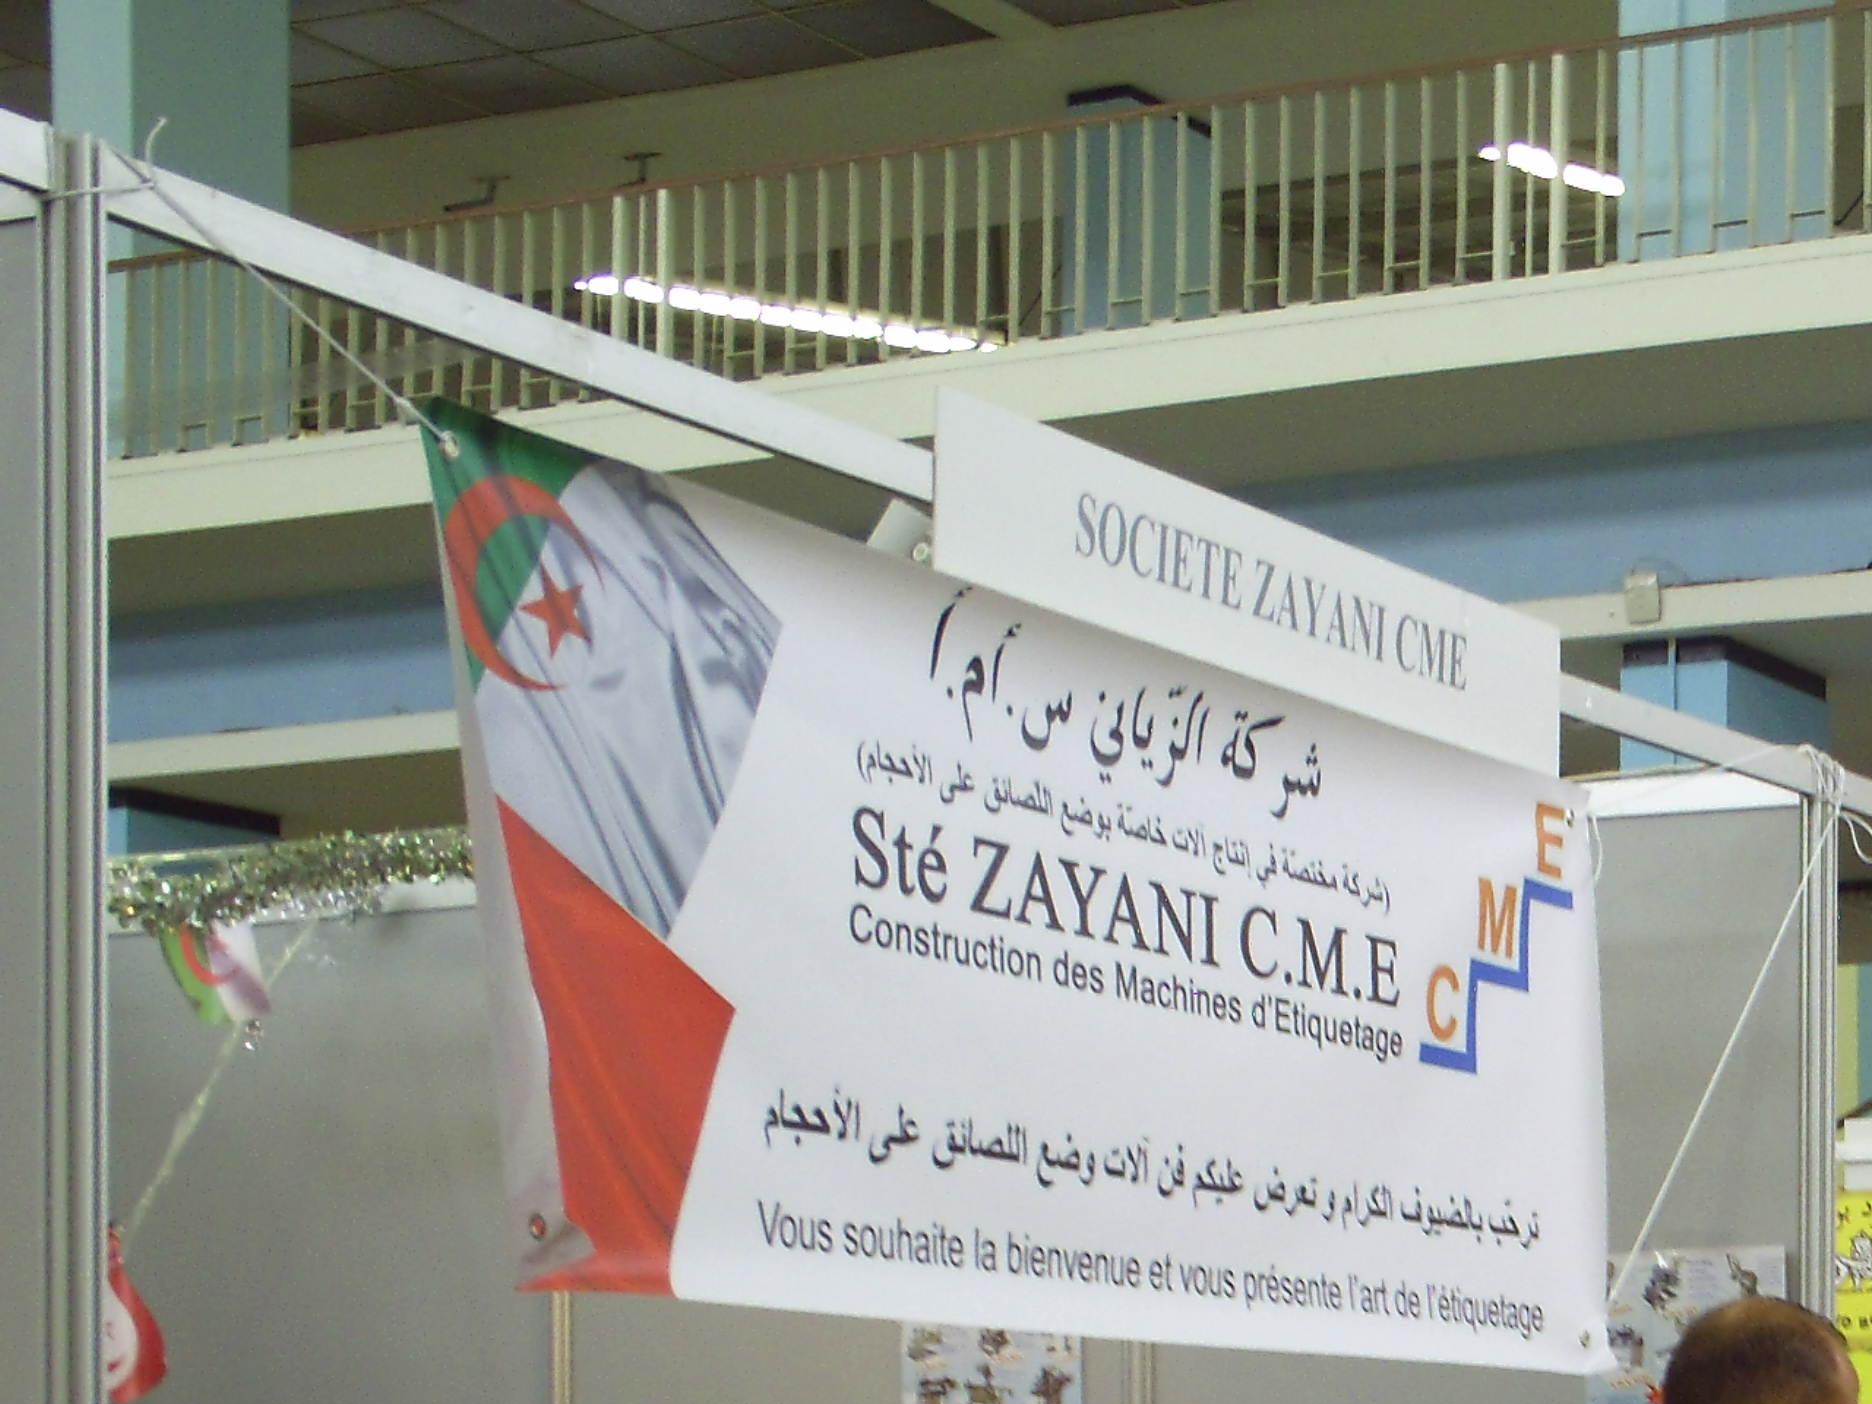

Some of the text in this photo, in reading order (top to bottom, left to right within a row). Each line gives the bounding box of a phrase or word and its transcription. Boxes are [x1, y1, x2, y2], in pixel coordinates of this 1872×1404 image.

[1075, 493, 1468, 691] SOCIETE ZAYANI CME
[939, 760, 975, 804] على
[1220, 710, 1322, 819] شركة
[1061, 797, 1112, 842] بوضع
[1257, 842, 1279, 889] في
[852, 805, 1400, 1008] Sté ZAYANI C.M.E
[850, 903, 1403, 1063] Construction des Machines d'Etiquetage
[763, 1085, 862, 1148] الأحجام
[868, 1102, 921, 1166] على
[1036, 1132, 1096, 1188] وضع
[1103, 1136, 1150, 1183] آلات
[1192, 1158, 1244, 1208] عليكم
[1342, 1179, 1394, 1231] الكرام
[1400, 1186, 1485, 1245] بالضيوف
[757, 1199, 1545, 1339] Vous souhaite la bienvenue et vous présente l'art de l'étiquetage
